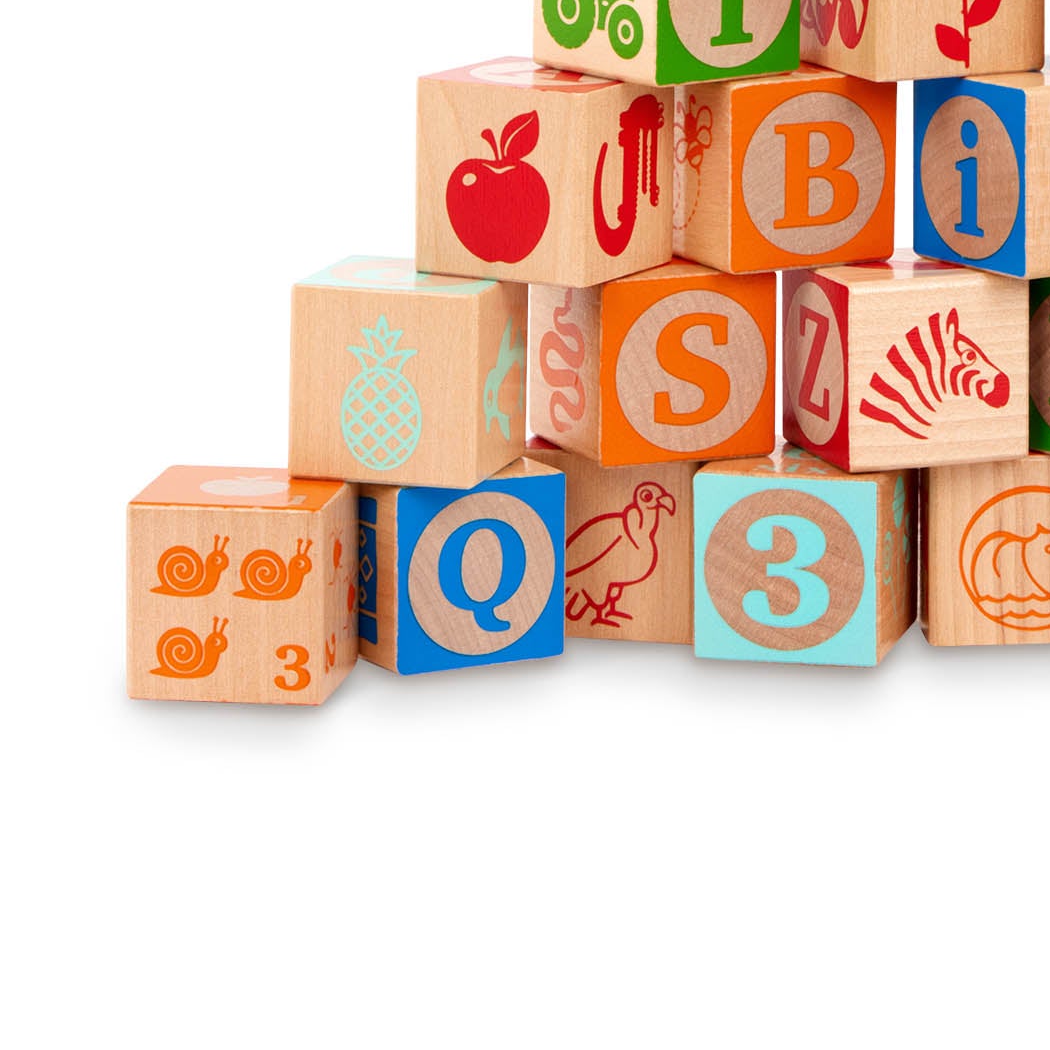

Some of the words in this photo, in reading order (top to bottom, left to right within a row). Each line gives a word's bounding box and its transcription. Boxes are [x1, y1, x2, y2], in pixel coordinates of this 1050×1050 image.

[773, 121, 859, 229] B
[955, 121, 984, 237] i
[654, 312, 730, 426] S
[798, 305, 829, 422] Z
[438, 519, 526, 632] Q
[743, 516, 829, 627] 3
[274, 645, 311, 691] 3
